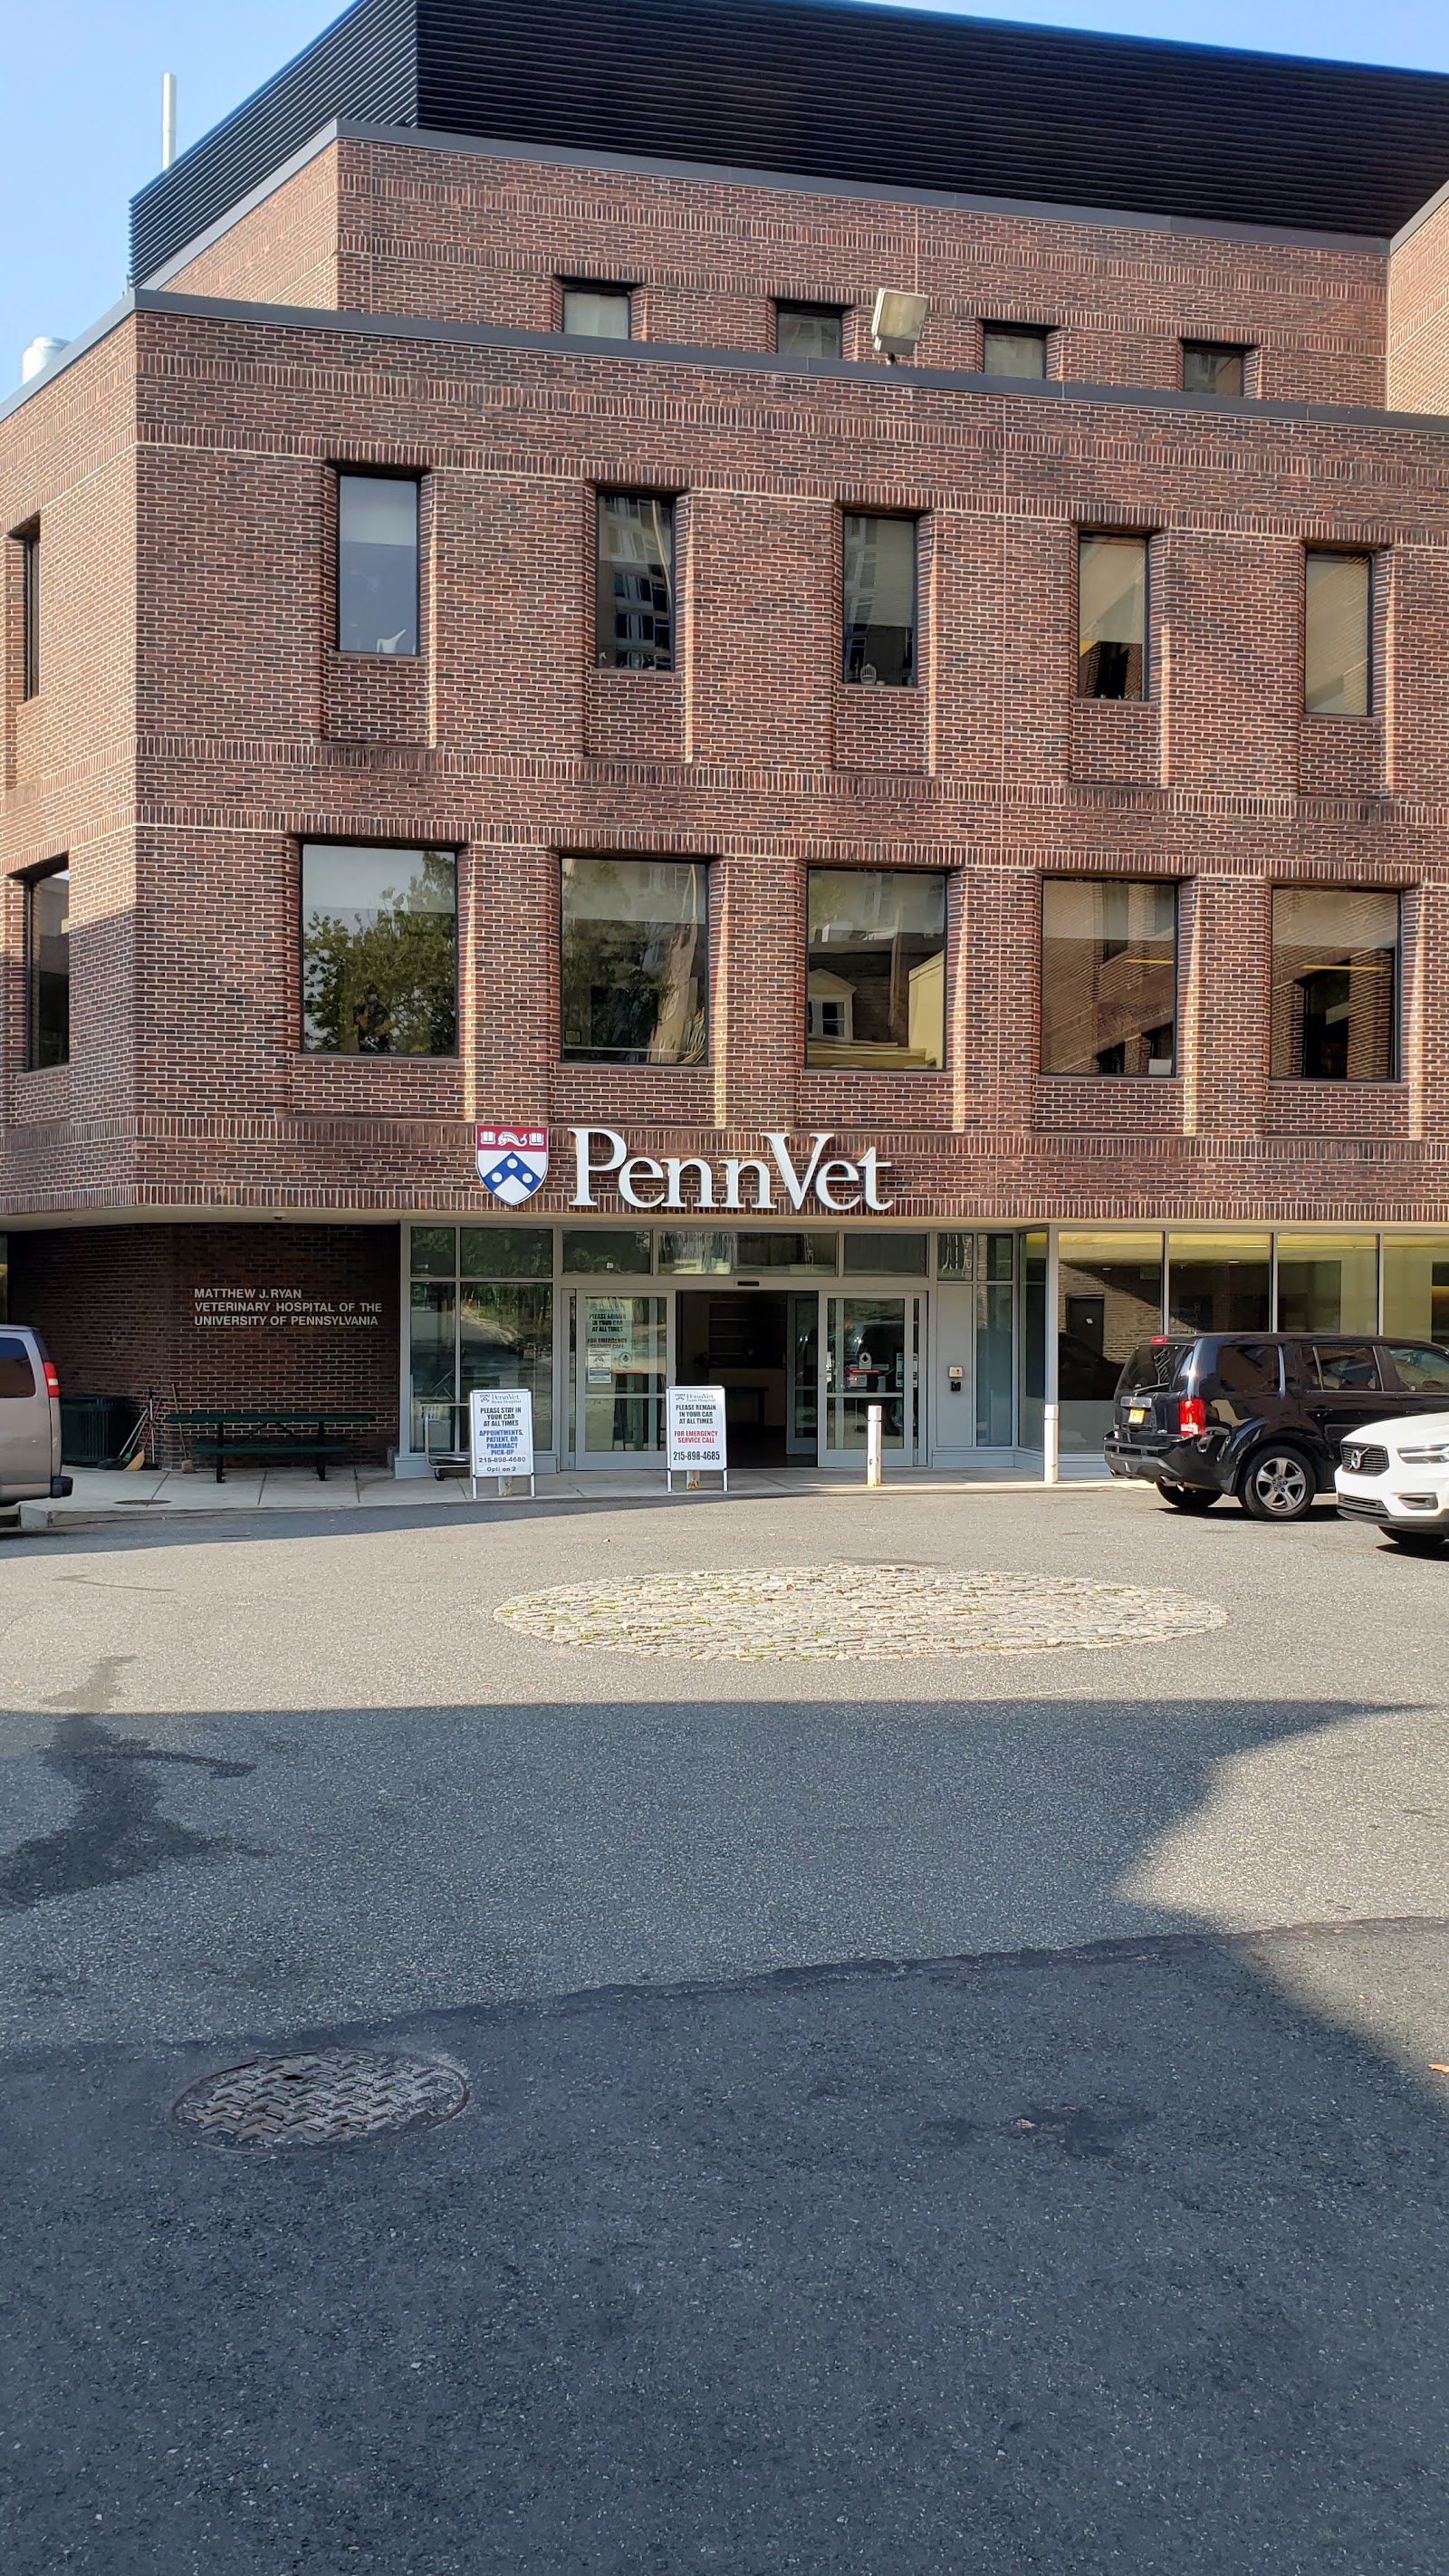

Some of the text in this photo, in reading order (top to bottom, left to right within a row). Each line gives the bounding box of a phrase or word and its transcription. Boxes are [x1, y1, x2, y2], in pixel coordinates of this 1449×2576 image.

[567, 1127, 894, 1210] PennVet
[194, 1288, 302, 1299] MATTHEW J. RYAN
[195, 1302, 383, 1312] VETERINARY HOSPITAL OF THE
[194, 1315, 379, 1326] UNIVERSITY OF PENNSYLVANIA
[673, 1451, 720, 1461] 215-898-4685
